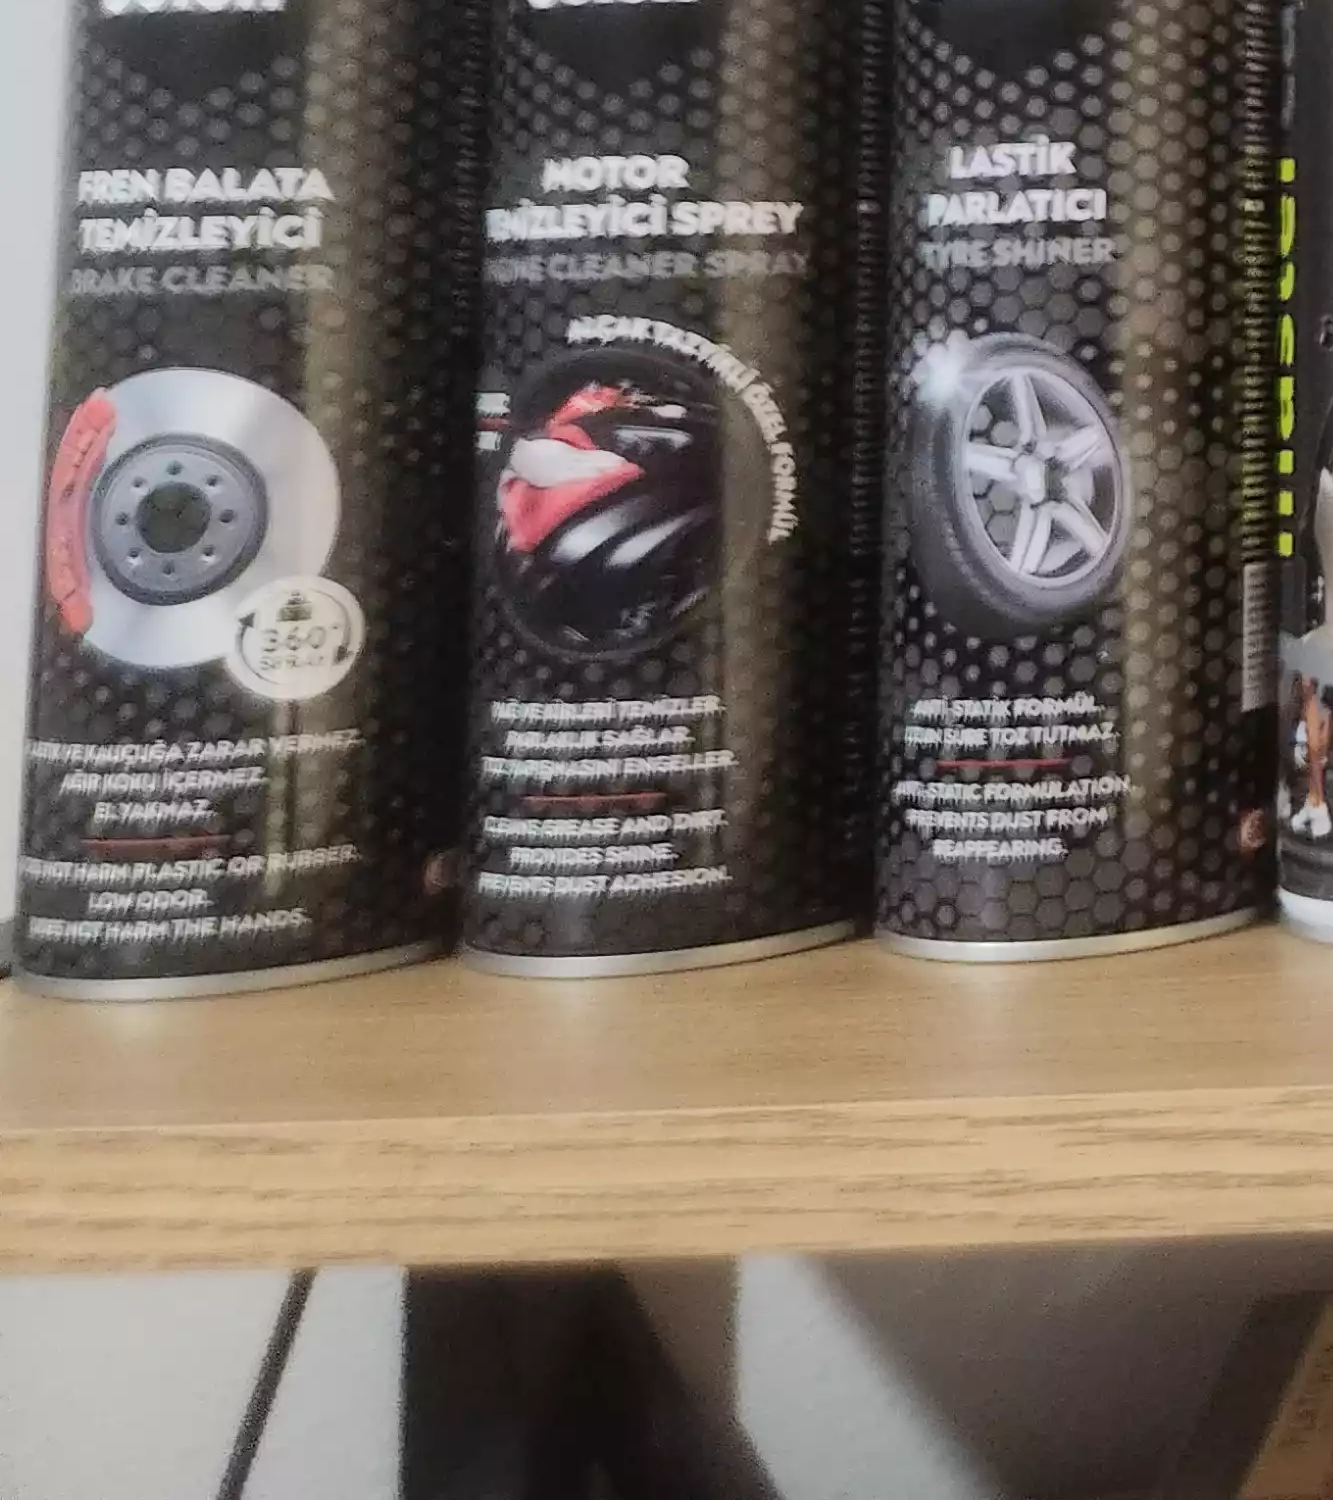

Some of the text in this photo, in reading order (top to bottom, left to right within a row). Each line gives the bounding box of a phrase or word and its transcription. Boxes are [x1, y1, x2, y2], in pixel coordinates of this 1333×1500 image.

[542, 154, 689, 192] MOTOR
[946, 134, 1077, 178] LASTİK
[79, 168, 335, 202] FREN BALATA
[671, 200, 804, 236] SPREY
[926, 188, 1107, 227] PARLATICI
[79, 206, 323, 251] TEMİZLEYİCİ
[161, 265, 334, 292] CLEANER
[1046, 807, 1109, 827] FROM
[227, 855, 266, 874] OR
